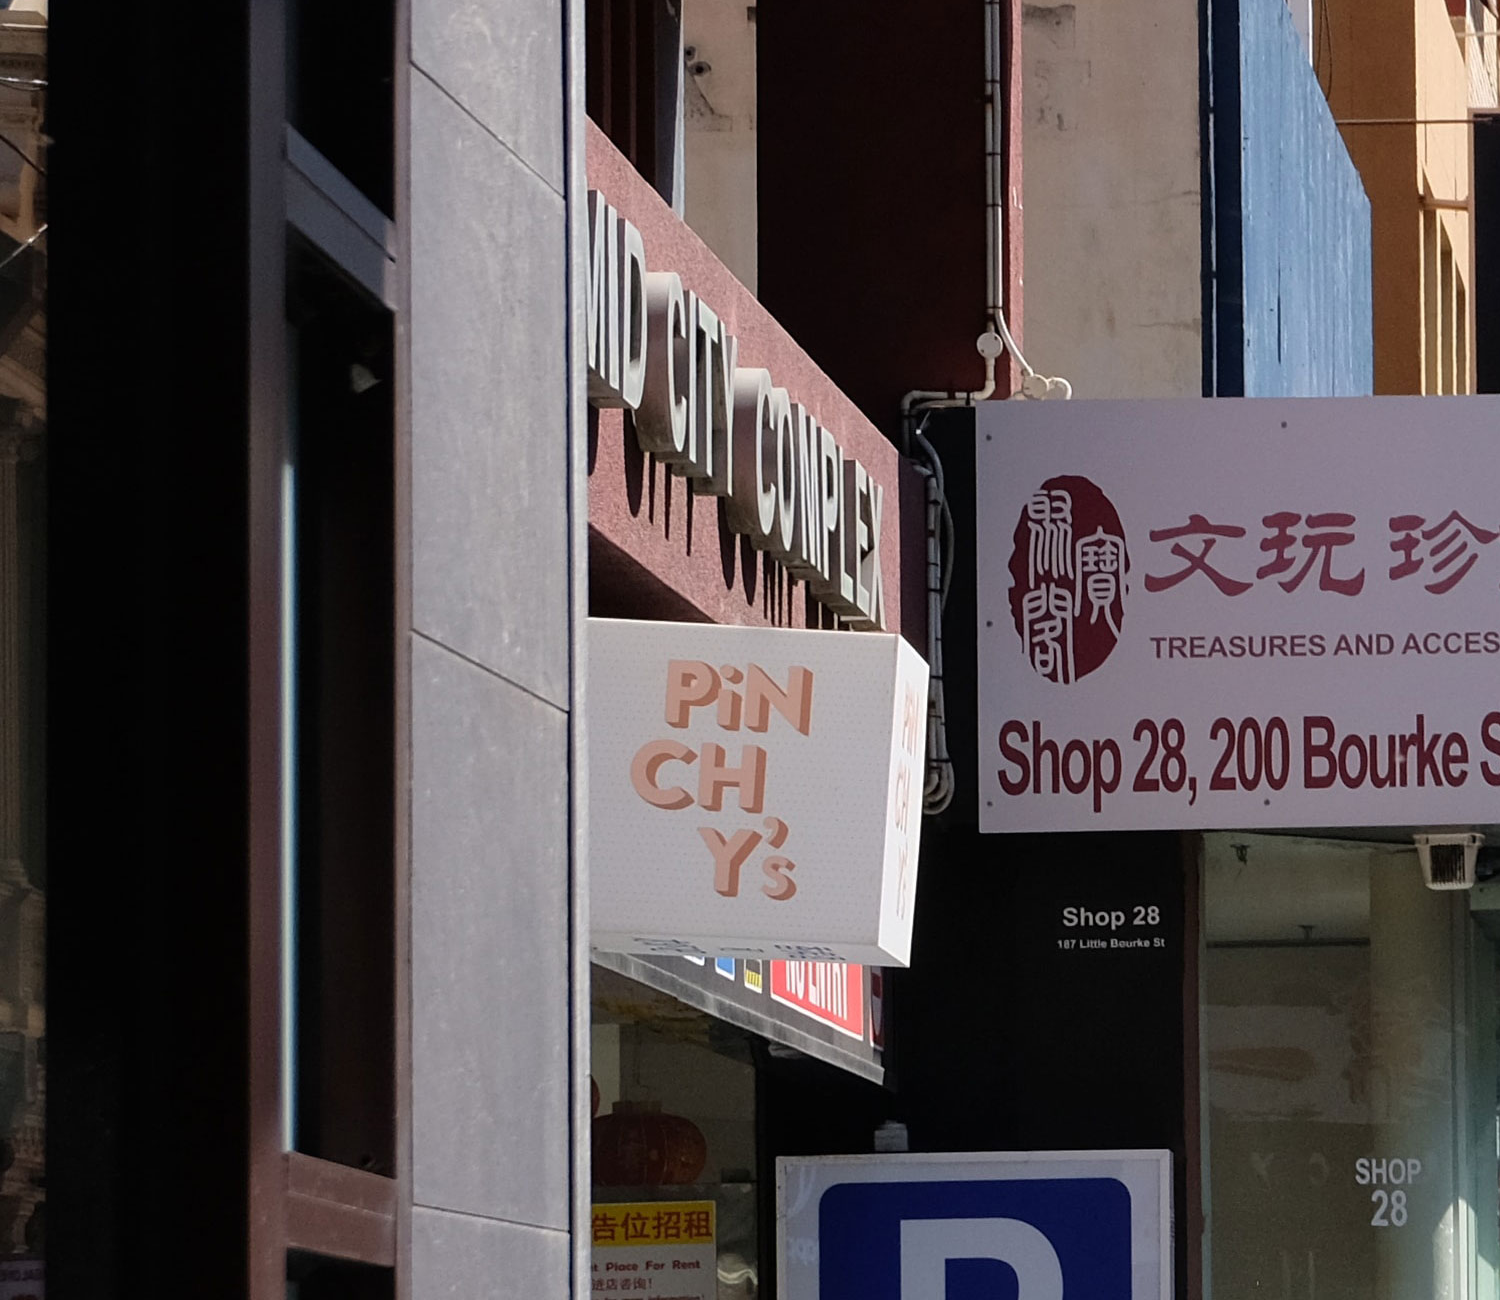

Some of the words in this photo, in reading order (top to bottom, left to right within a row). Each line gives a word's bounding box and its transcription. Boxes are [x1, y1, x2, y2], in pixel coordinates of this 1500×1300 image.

[655, 273, 739, 498] CITY
[748, 368, 887, 631] COMPLEX
[1150, 634, 1327, 660] TREASURES
[1332, 632, 1395, 657] AND
[629, 738, 767, 815] CH
[996, 718, 1122, 813] Shop
[1132, 717, 1200, 807] 28,
[1208, 715, 1291, 793] 200
[1303, 712, 1470, 792] Bourke
[1062, 906, 1126, 931] Shop
[1133, 905, 1161, 927] 28
[1079, 937, 1108, 950] Little
[1109, 936, 1150, 950] Bourke
[1152, 935, 1167, 949] St
[1354, 1157, 1423, 1186] SHOP
[1370, 1190, 1410, 1228] 28
[591, 1210, 713, 1242] 告位招租
[645, 1260, 665, 1271] For
[672, 1259, 701, 1270] Rent
